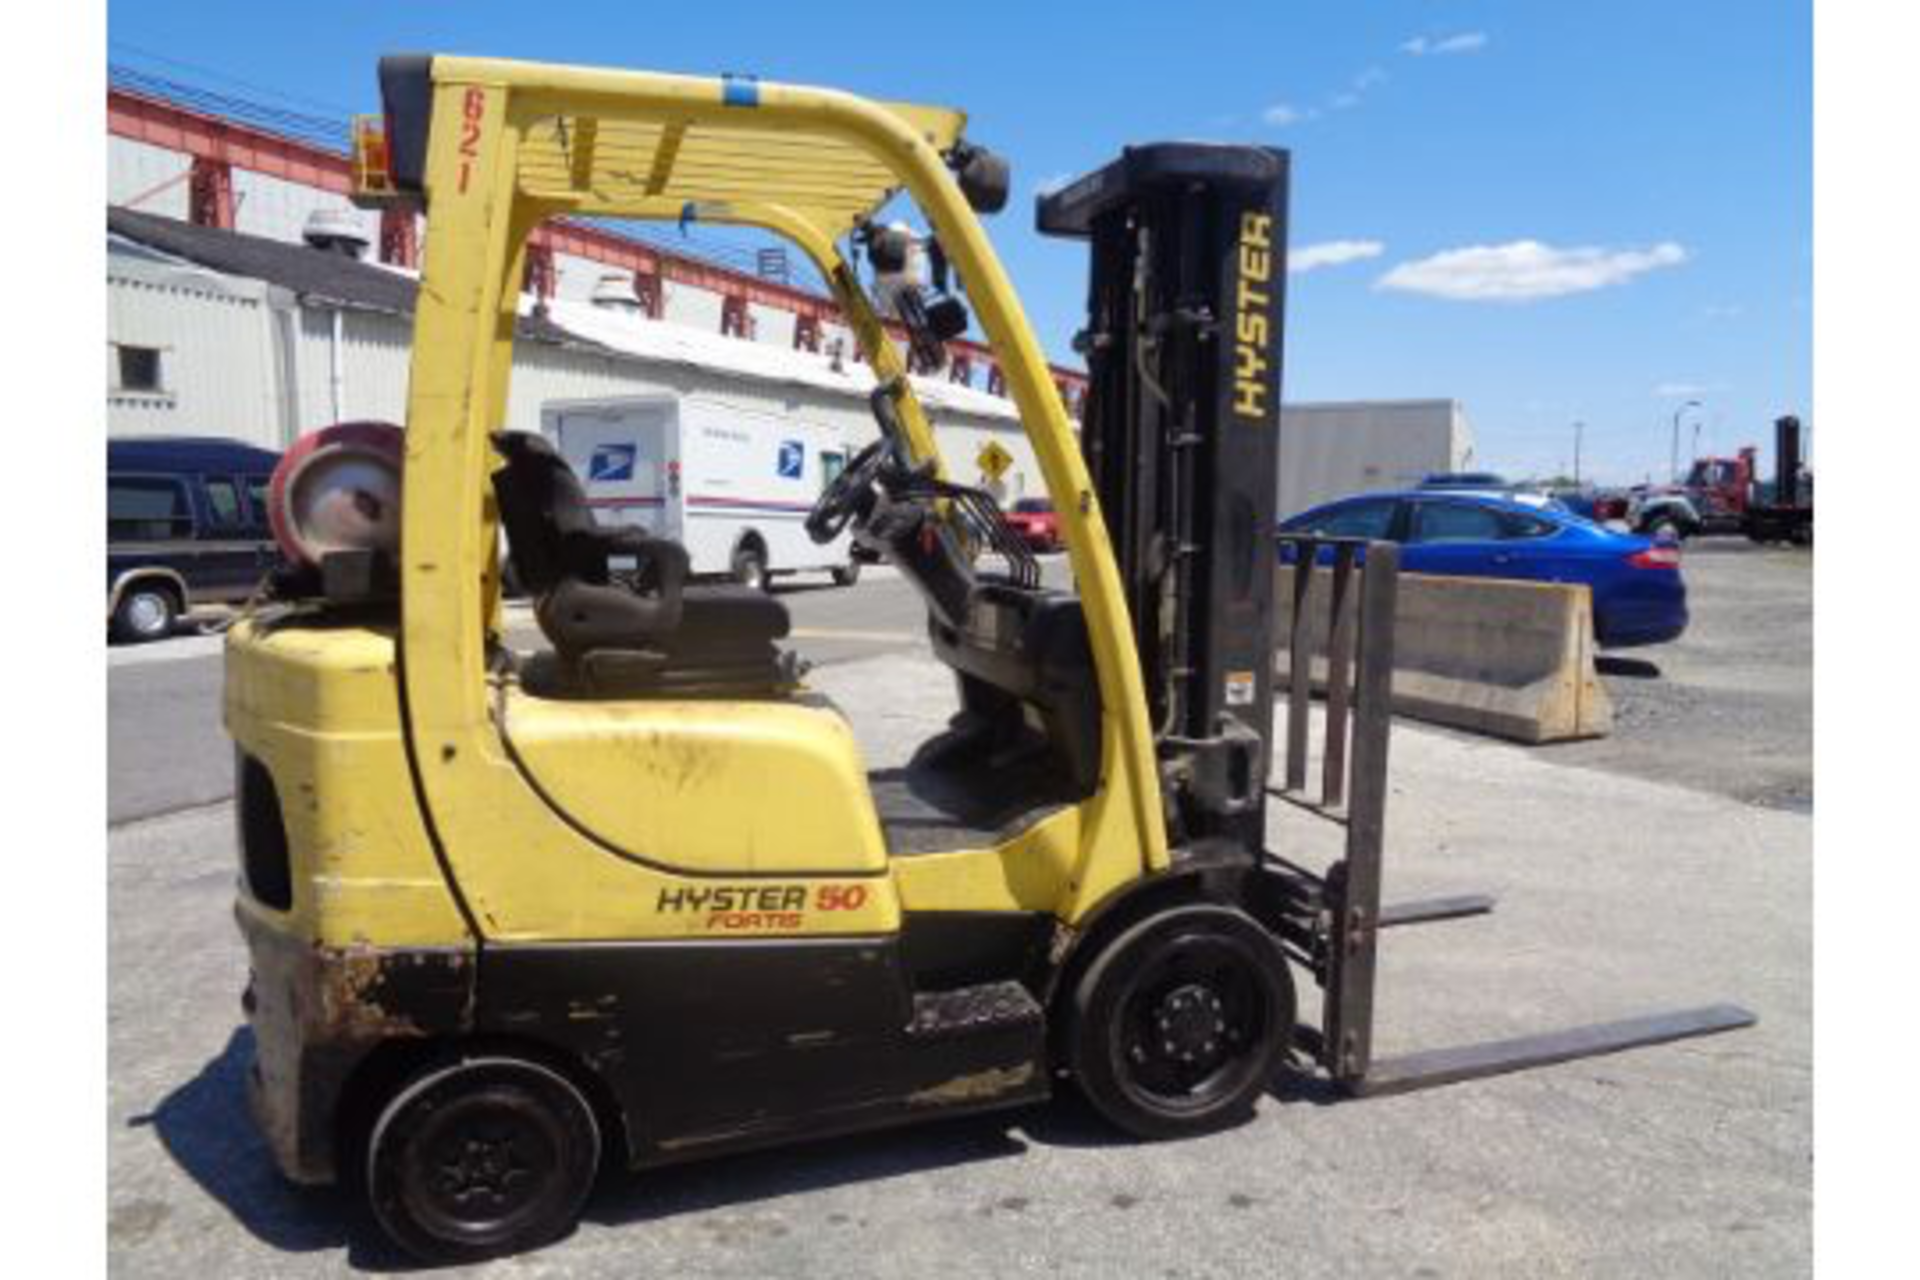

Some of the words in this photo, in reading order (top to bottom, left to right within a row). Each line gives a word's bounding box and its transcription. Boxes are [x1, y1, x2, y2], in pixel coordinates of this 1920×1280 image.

[457, 87, 484, 196] 621
[1233, 211, 1271, 417] HYSTER
[656, 884, 807, 912] HYSTER
[815, 884, 868, 911] 50
[707, 912, 804, 929] FORTIS
